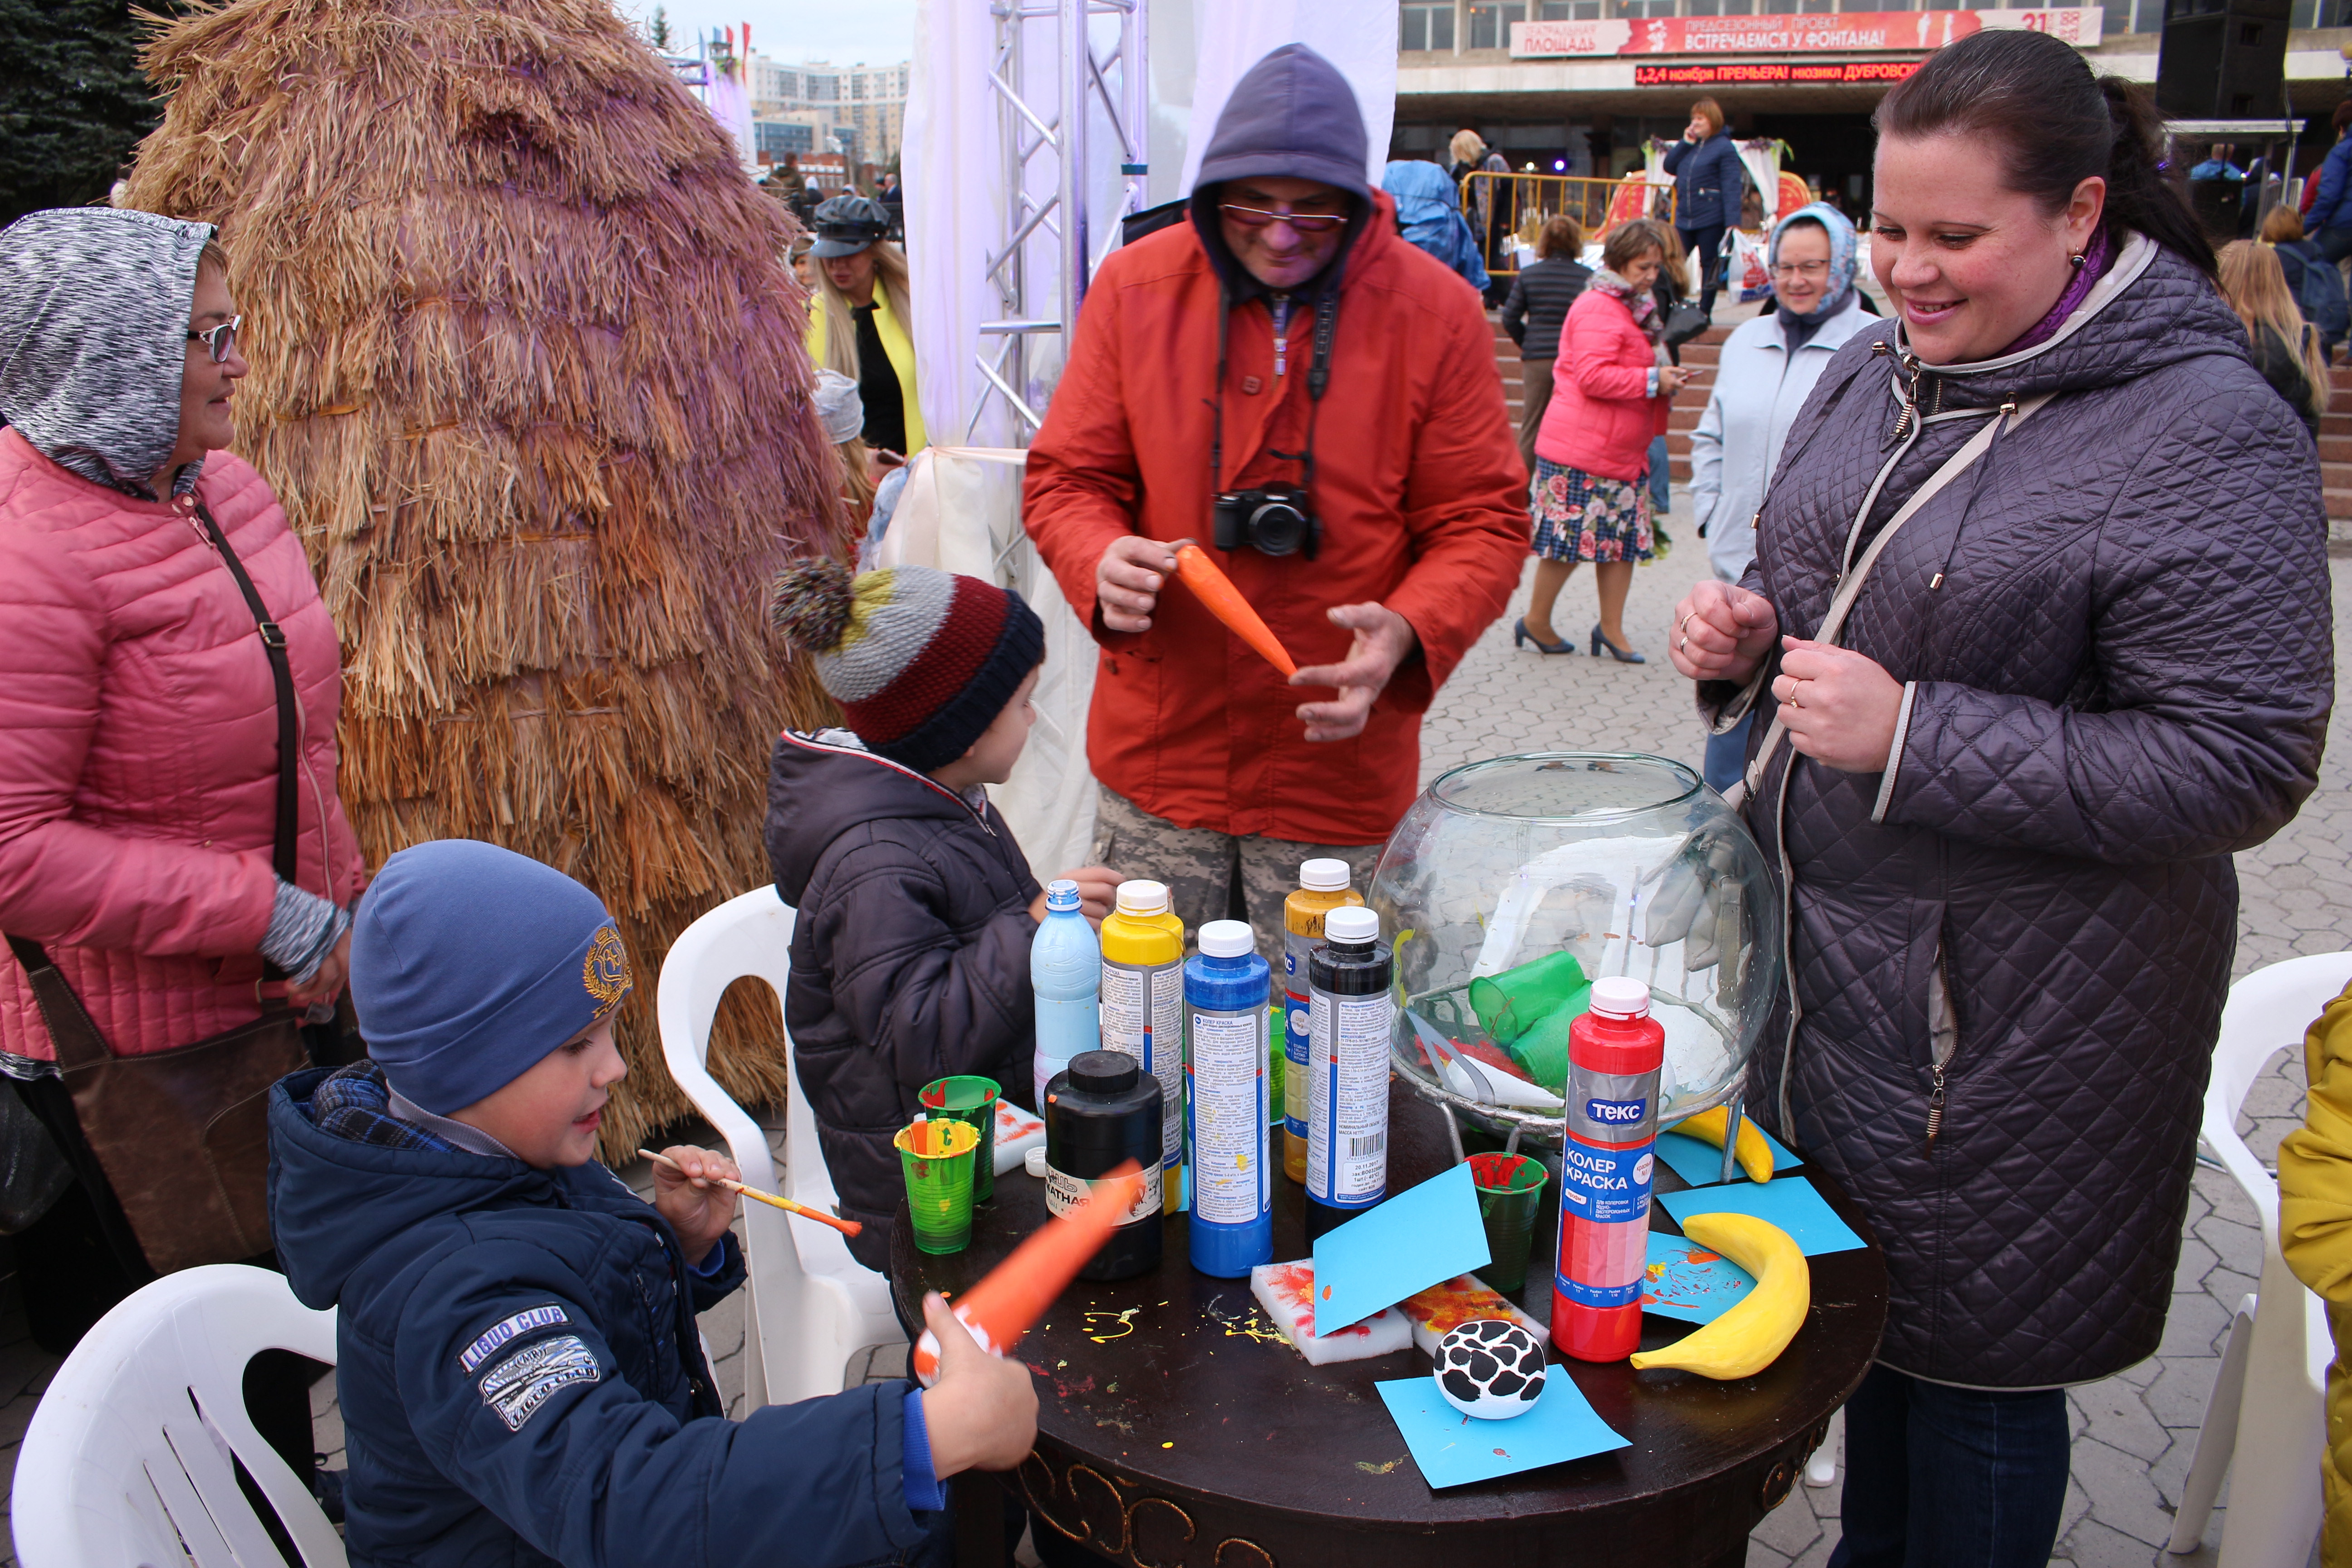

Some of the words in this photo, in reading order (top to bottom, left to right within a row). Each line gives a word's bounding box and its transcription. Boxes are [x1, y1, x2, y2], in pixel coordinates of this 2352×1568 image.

[1685, 17, 1783, 32] ПРЕДСЕЗОННЫЙ
[1791, 17, 1838, 30] ПРОЕКТ
[1524, 38, 1596, 52] ПЛОЩАДЬ
[1685, 32, 1788, 50] ВСТРЕЧАЕМСЯ
[1792, 32, 1803, 48] У
[1805, 30, 1886, 47] ФОНТАНА!
[1636, 68, 1666, 83] 1,2,4
[1669, 67, 1714, 83] ноября
[1717, 66, 1789, 80] ПРЕМЬЕРА!
[1792, 66, 1842, 79] мюзикл
[1567, 1147, 1617, 1174] КОЛЕР
[1636, 1159, 1652, 1172] красный
[1566, 1164, 1628, 1190] КРАСКА
[1568, 1191, 1581, 1202] профи
[463, 1322, 514, 1368] LIGUO
[516, 1307, 564, 1330] CLUB
